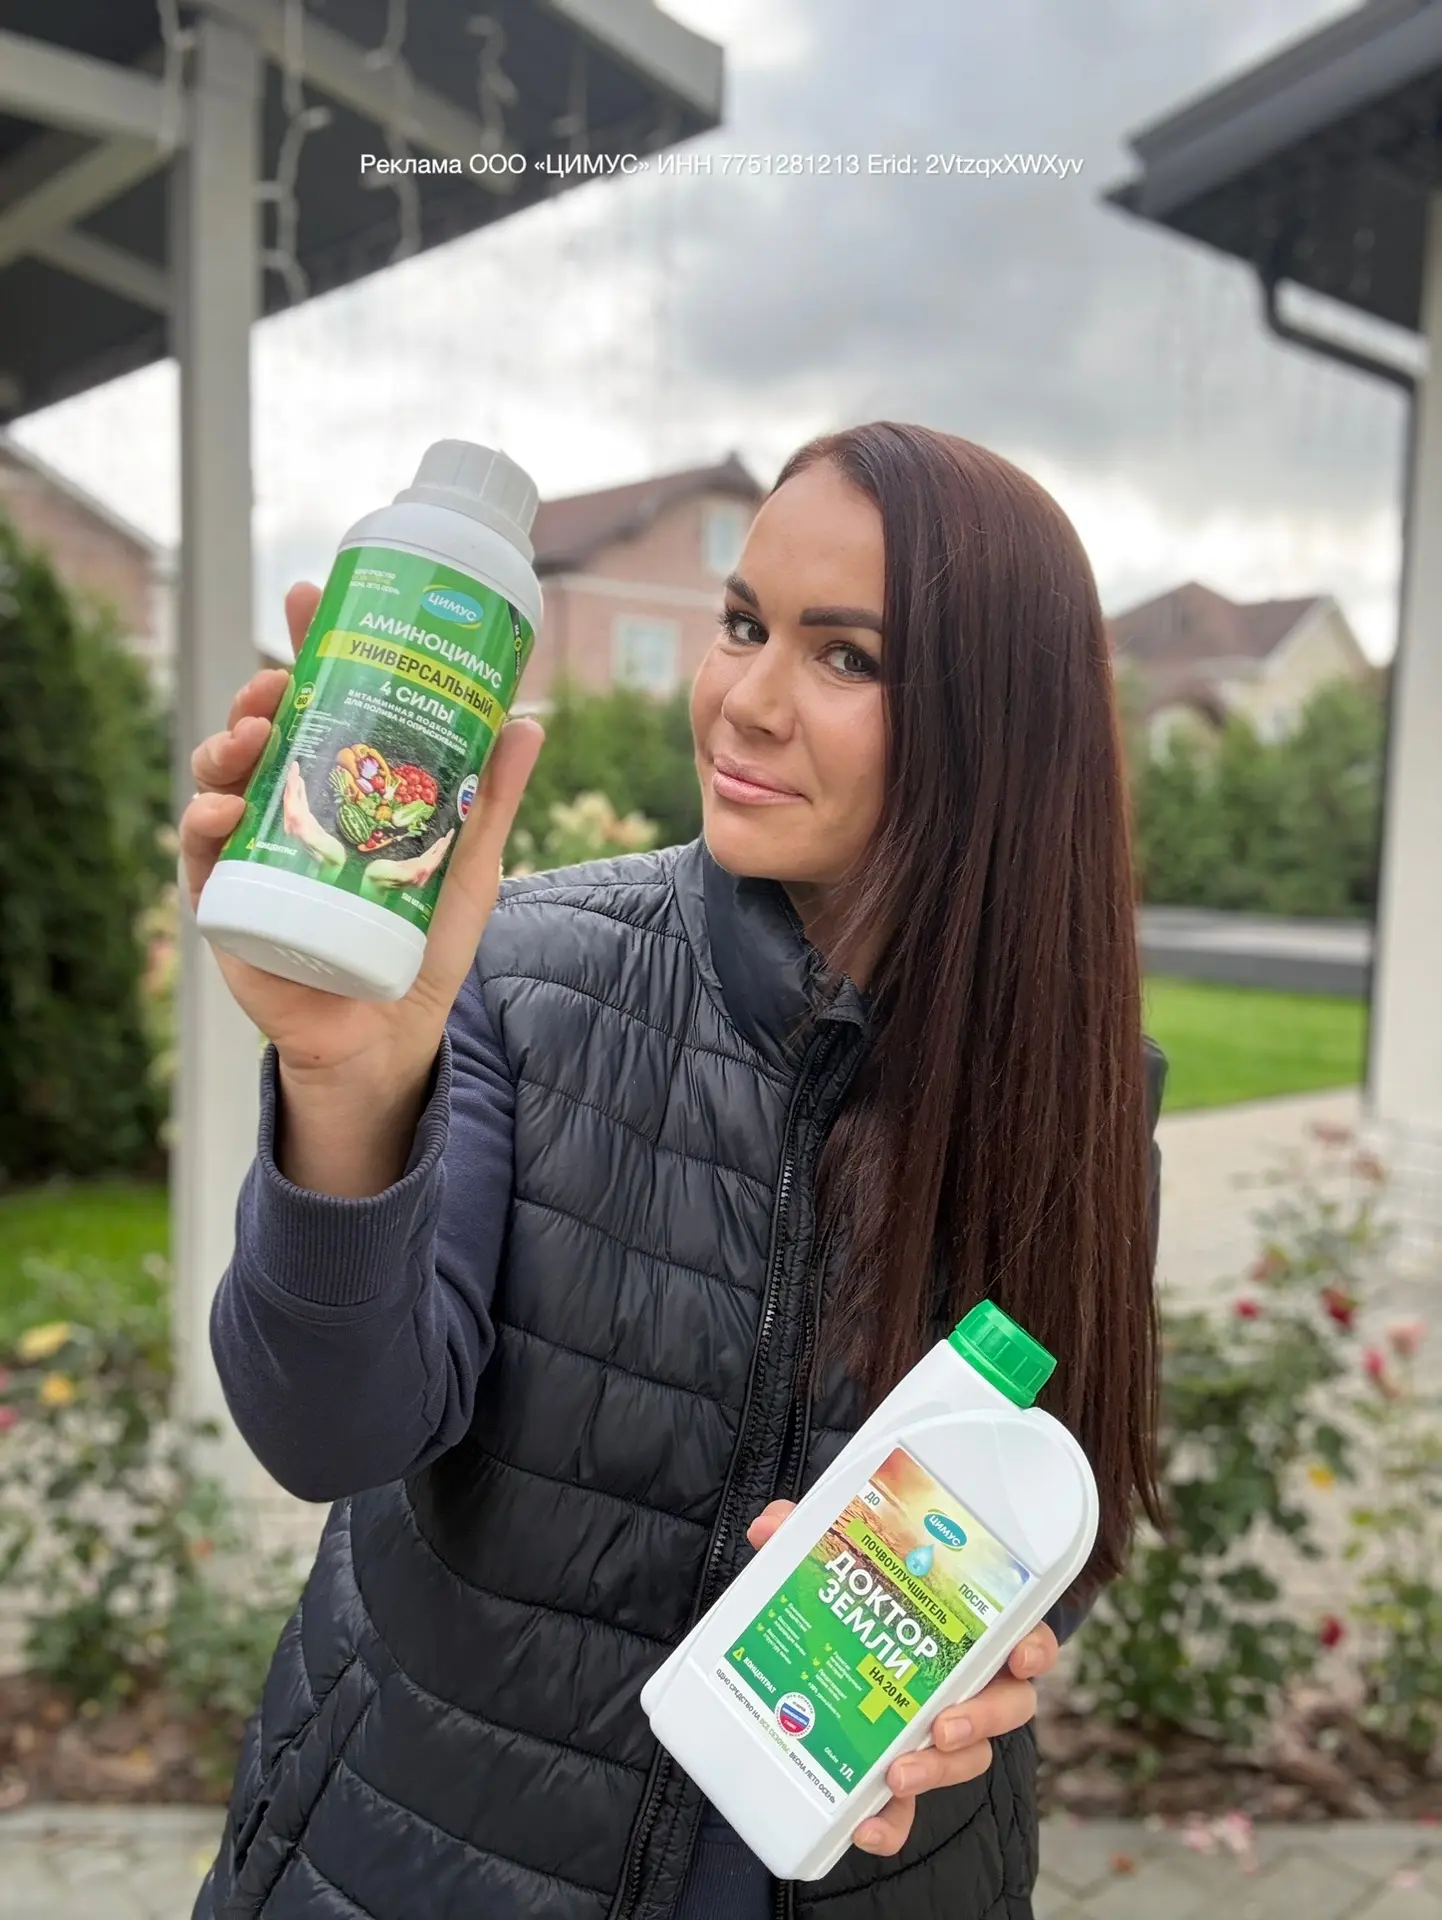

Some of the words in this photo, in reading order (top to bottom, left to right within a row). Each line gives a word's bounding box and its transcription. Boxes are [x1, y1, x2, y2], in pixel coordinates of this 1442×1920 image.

[428, 592, 478, 622] ЦИМУС
[349, 639, 493, 719] УНИВЕРСАЛЬНЫЙ
[359, 611, 503, 690] АМИНОЦИМУС
[344, 697, 363, 709] ДЛЯ
[363, 701, 399, 721] ПОЛИВА
[398, 715, 407, 725] И
[406, 718, 467, 757] ОПРЫСКИВАНИЯ
[347, 689, 415, 721] ВИТАМИННАЯ
[416, 715, 469, 749] ПОДКОРМКА
[380, 680, 392, 696] 4
[395, 685, 457, 724] СИЛЫ
[864, 1491, 881, 1506] ДО
[929, 1515, 962, 1547] ЦИМУС
[825, 1552, 939, 1658] ДОКТОР
[861, 1534, 948, 1626] ПОЧВОУЛУЧШИТЕЛЬ
[959, 1583, 989, 1616] ПОСЛЕ
[818, 1579, 914, 1680] ЗЕМЛИ
[743, 1656, 776, 1694] КОНЦЕНТРАТ
[868, 1667, 887, 1688] НА
[881, 1682, 898, 1698] 20
[716, 1668, 732, 1686] ОДНО
[729, 1683, 754, 1716] СРЕДСТВО
[752, 1709, 761, 1721] НА
[759, 1717, 771, 1731] ВСЕ
[788, 1751, 807, 1773] ВЕСНА
[805, 1769, 820, 1786] ЛЕТО
[818, 1783, 836, 1804] ОСЕНЬ
